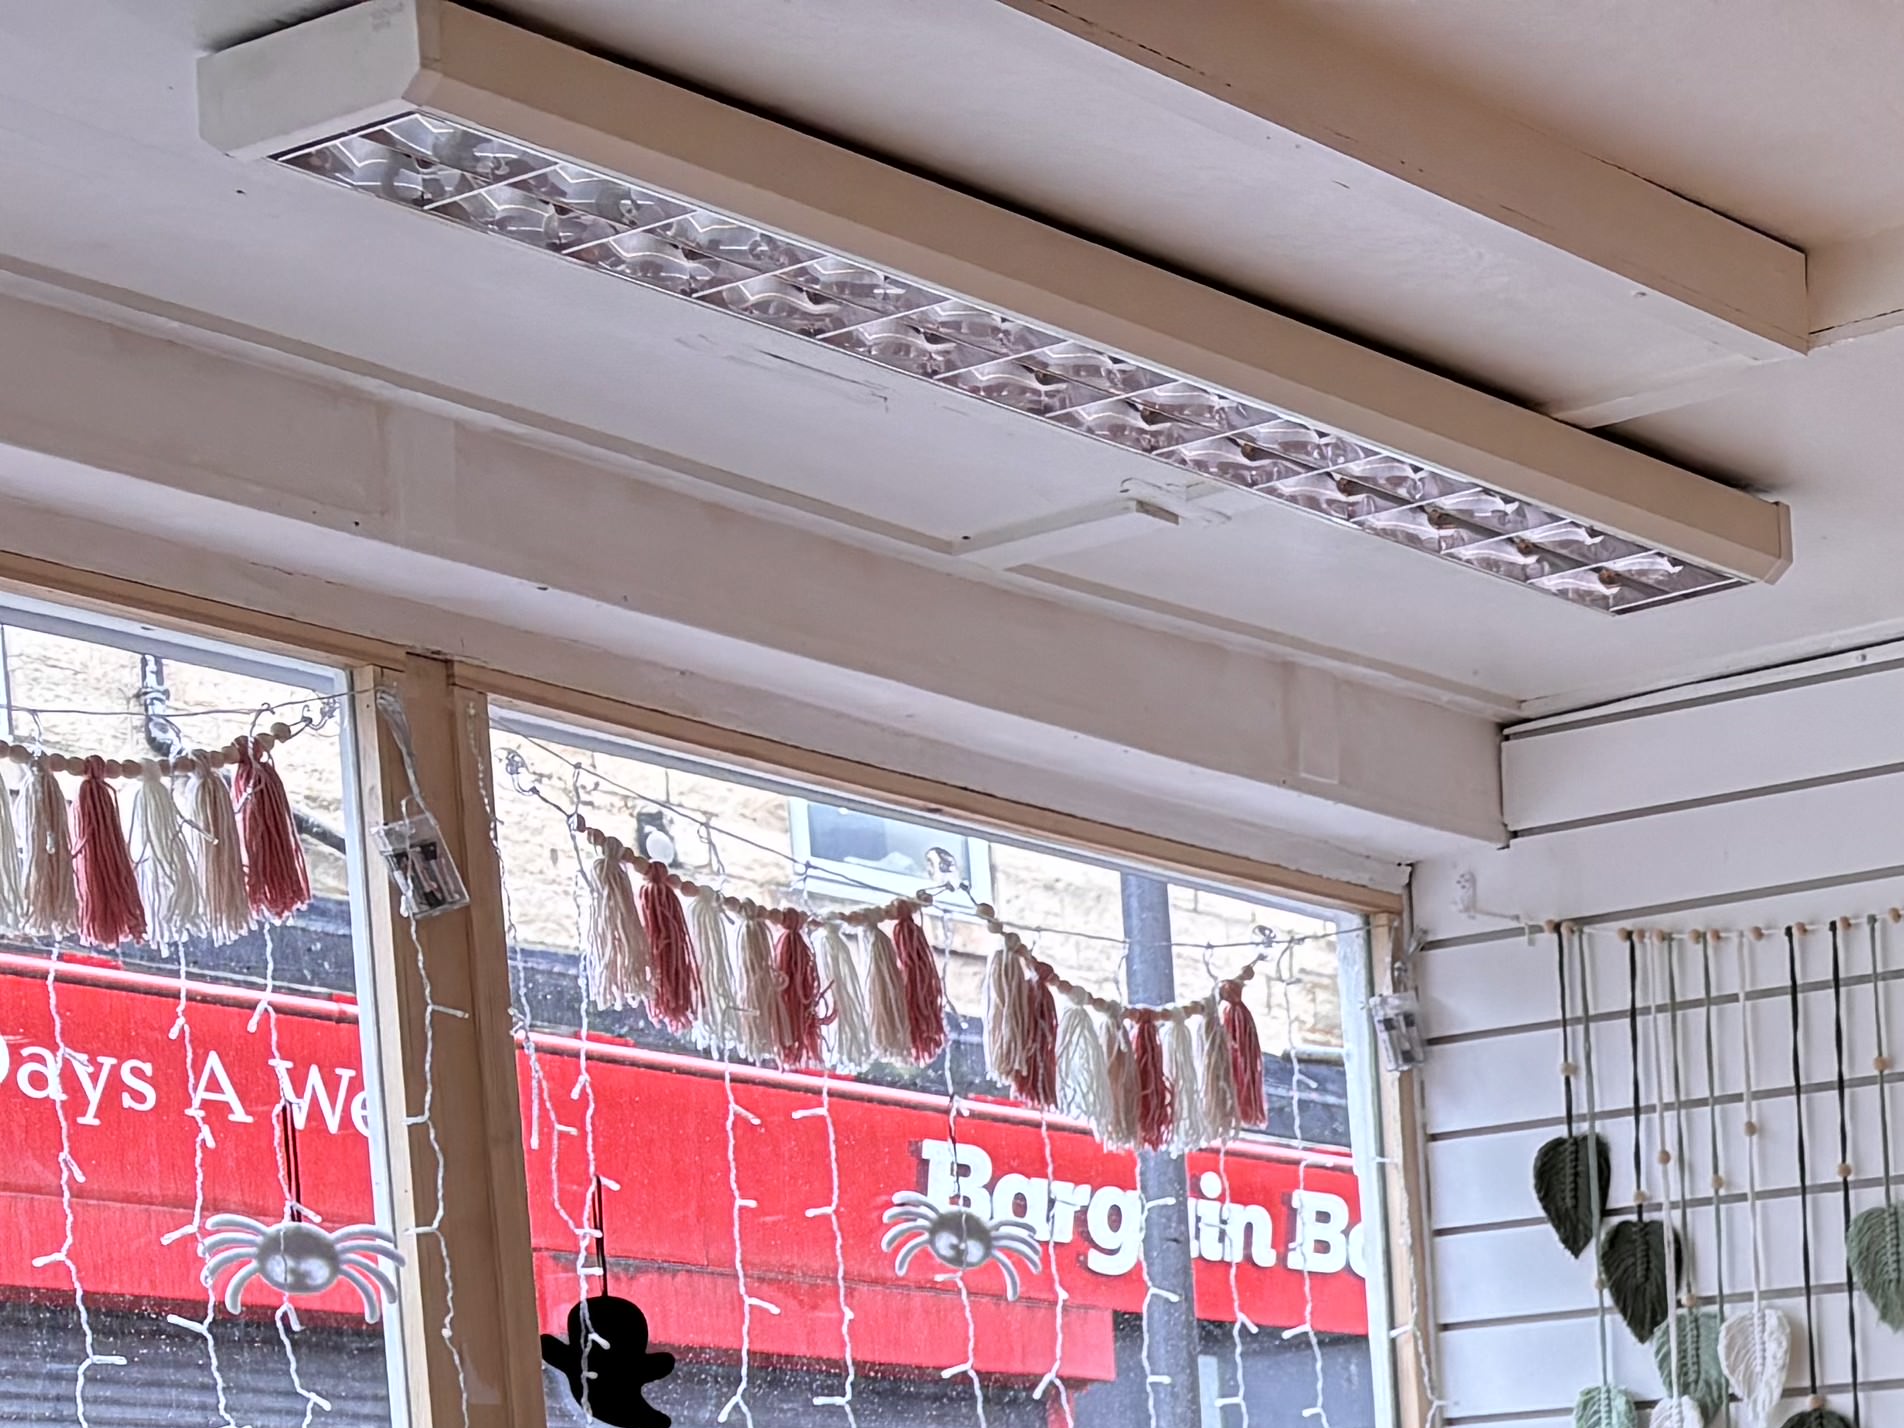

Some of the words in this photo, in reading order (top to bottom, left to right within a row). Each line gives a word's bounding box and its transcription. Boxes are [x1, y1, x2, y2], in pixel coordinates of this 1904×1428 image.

[0, 1033, 157, 1125] ays
[184, 1050, 254, 1124] A
[920, 1138, 1277, 1277] Bargin
